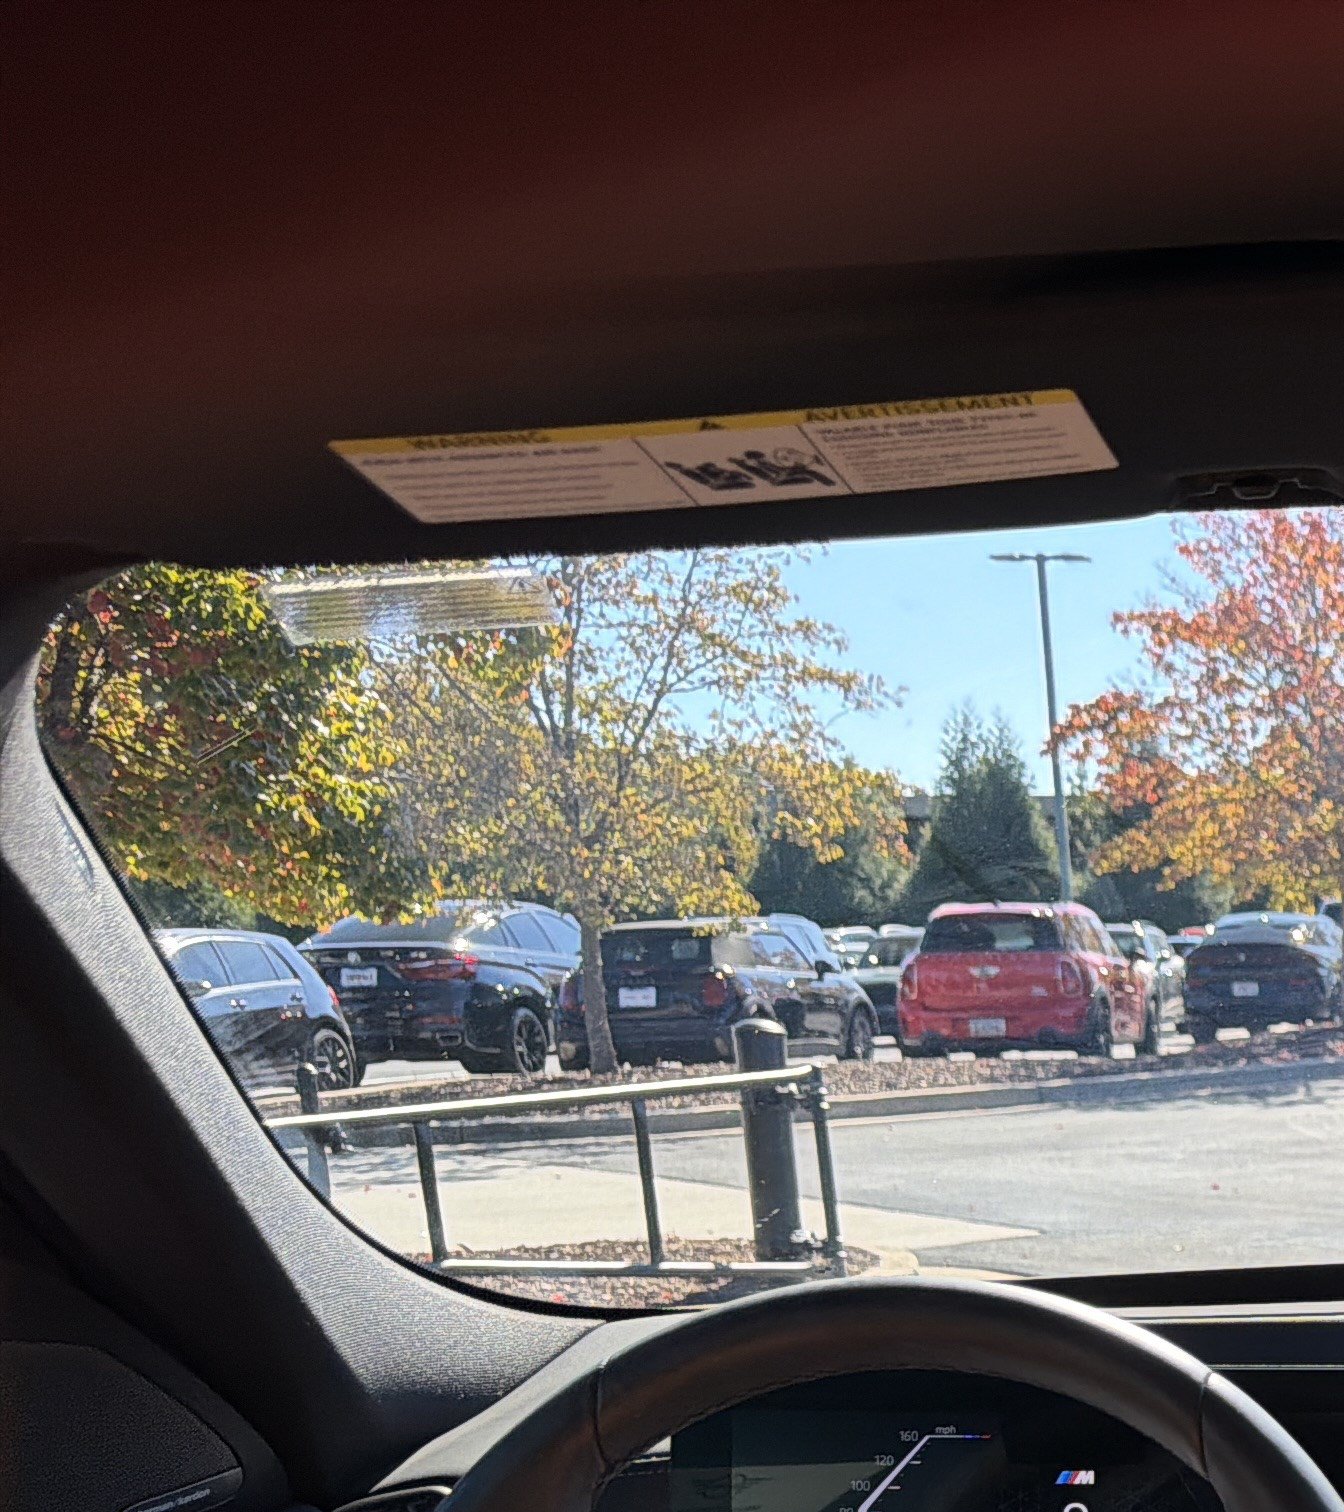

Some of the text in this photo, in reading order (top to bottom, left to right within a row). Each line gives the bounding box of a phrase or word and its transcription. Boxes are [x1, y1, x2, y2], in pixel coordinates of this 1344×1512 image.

[935, 1425, 957, 1435] mph
[899, 1430, 919, 1442] 160
[874, 1455, 895, 1466] 120
[850, 1481, 871, 1492] 100
